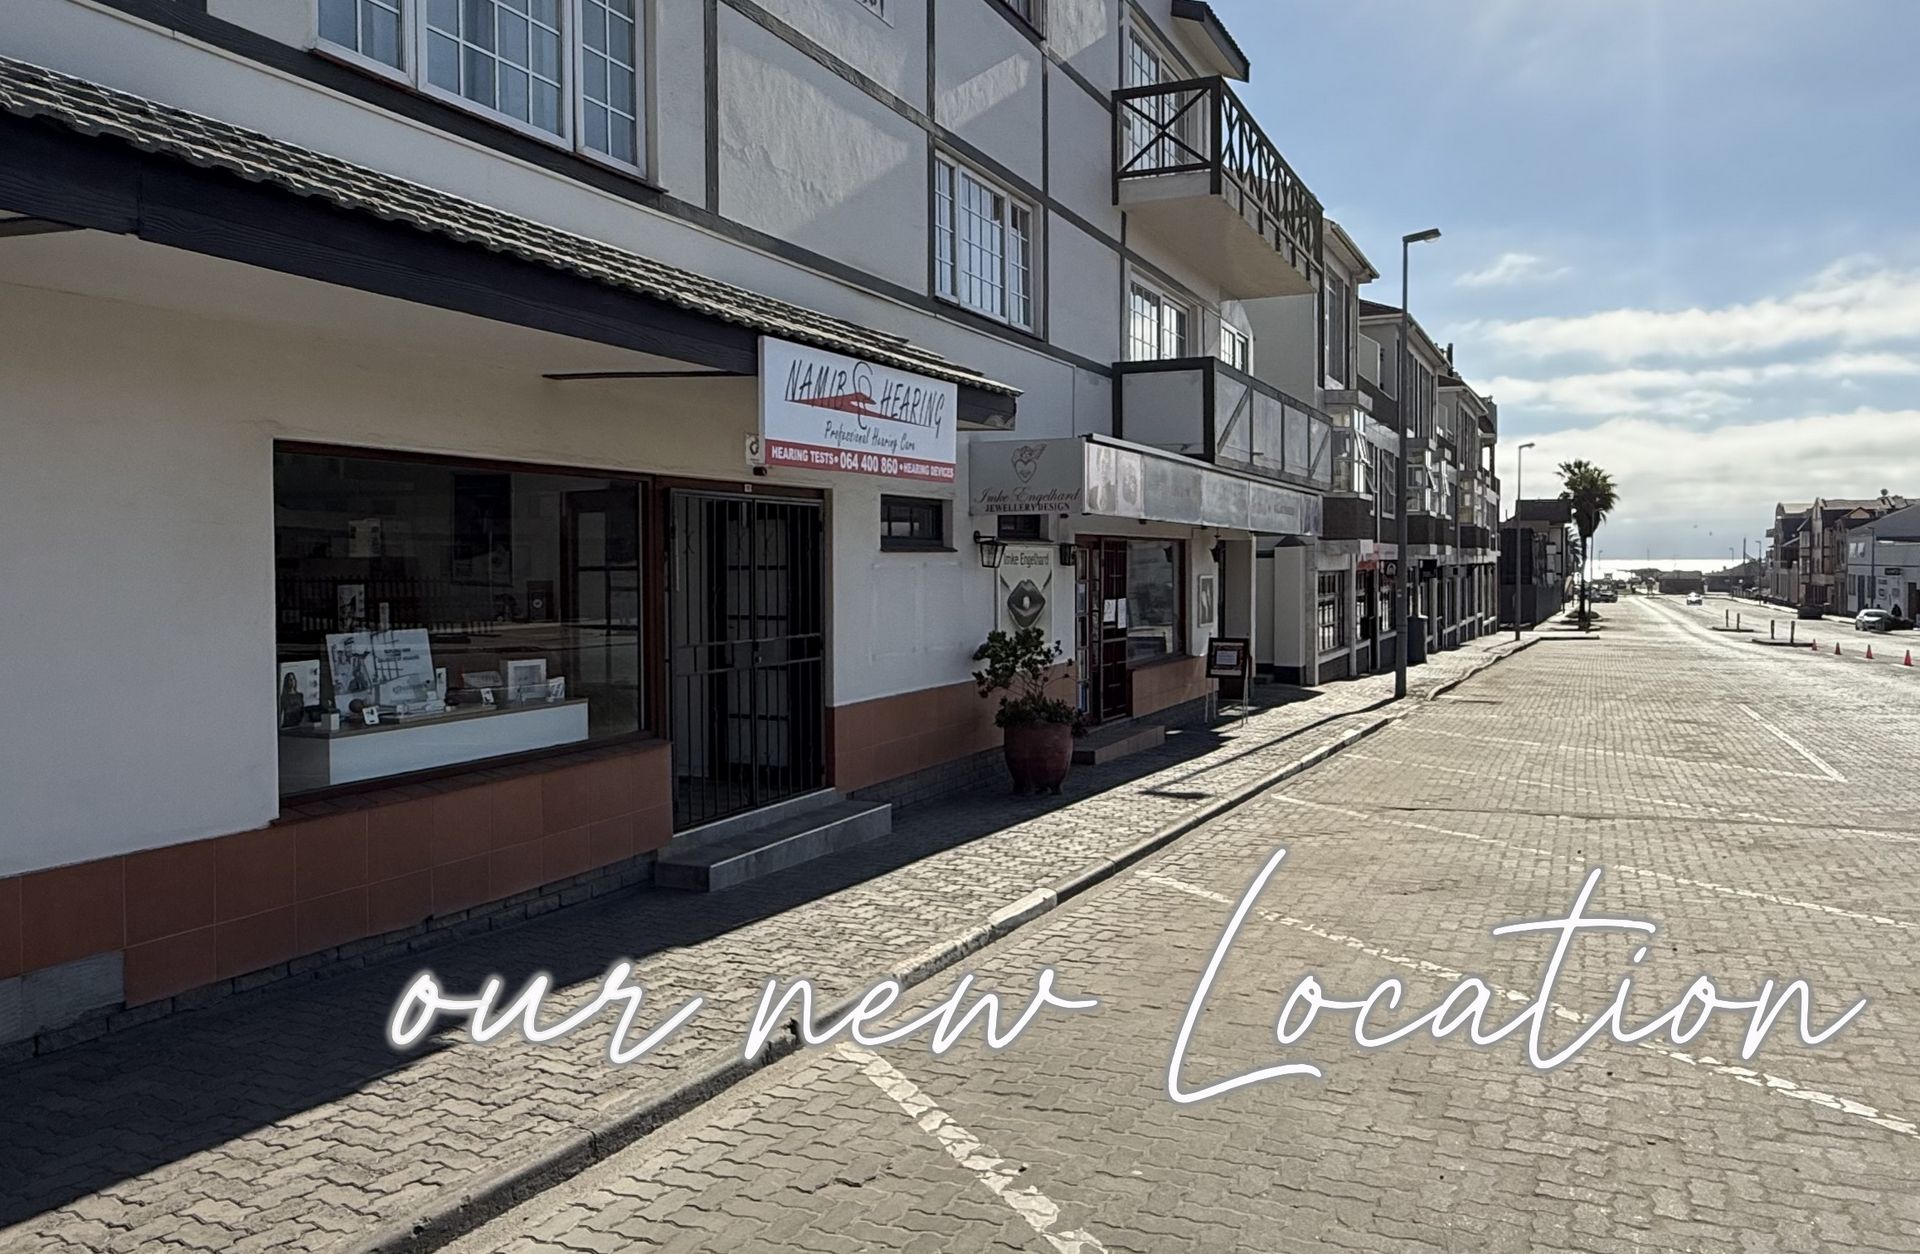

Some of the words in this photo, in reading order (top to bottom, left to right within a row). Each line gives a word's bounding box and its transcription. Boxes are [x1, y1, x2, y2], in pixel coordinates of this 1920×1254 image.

[784, 359, 848, 409] NAMIB
[880, 379, 945, 439] HEARING
[824, 420, 872, 448] Professional
[872, 427, 898, 455] Hearing
[771, 445, 809, 462] HEARING
[810, 450, 834, 465] TESTS
[840, 451, 860, 472] 064
[860, 453, 880, 473] 400
[880, 456, 899, 475] 860
[903, 462, 930, 476] HEARING
[930, 464, 954, 478] DEVICES
[978, 487, 1010, 504] Imke
[1012, 486, 1082, 507] Engelhard
[984, 503, 1035, 513] JEWELLERY
[1037, 502, 1070, 512] DESIGN
